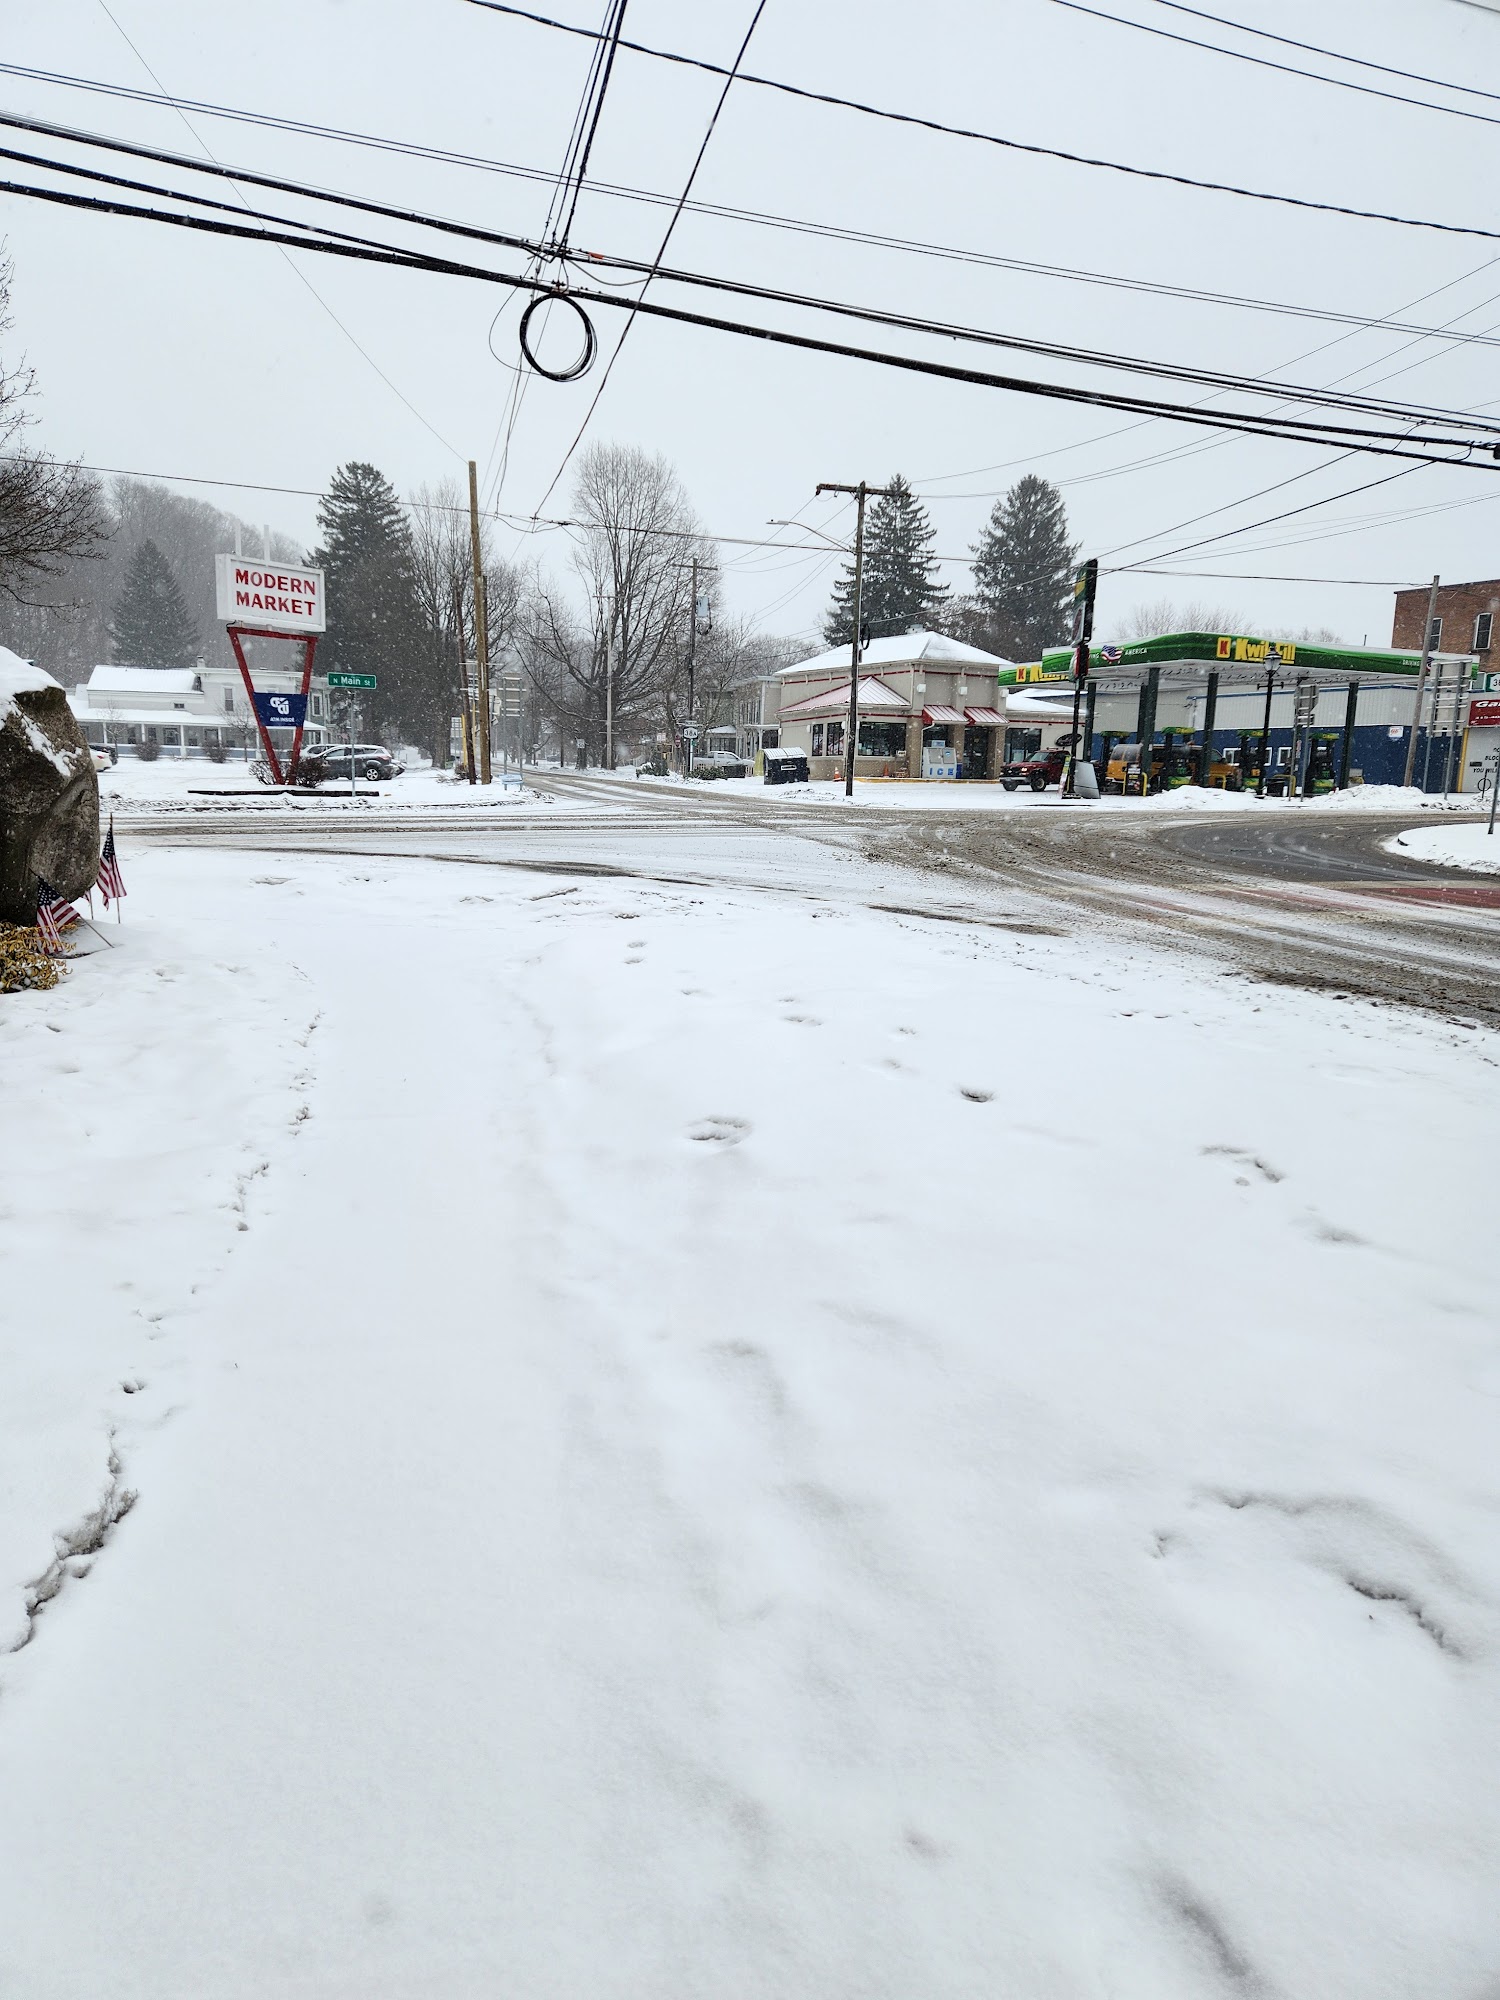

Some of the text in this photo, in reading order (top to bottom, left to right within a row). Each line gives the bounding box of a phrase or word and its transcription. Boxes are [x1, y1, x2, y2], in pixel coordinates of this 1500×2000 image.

[235, 568, 316, 596] MODERN
[236, 590, 316, 616] MARKET
[1124, 647, 1148, 656] AMERICA
[340, 676, 361, 686] Main
[685, 729, 697, 737] 38A
[929, 767, 954, 776] ICE
